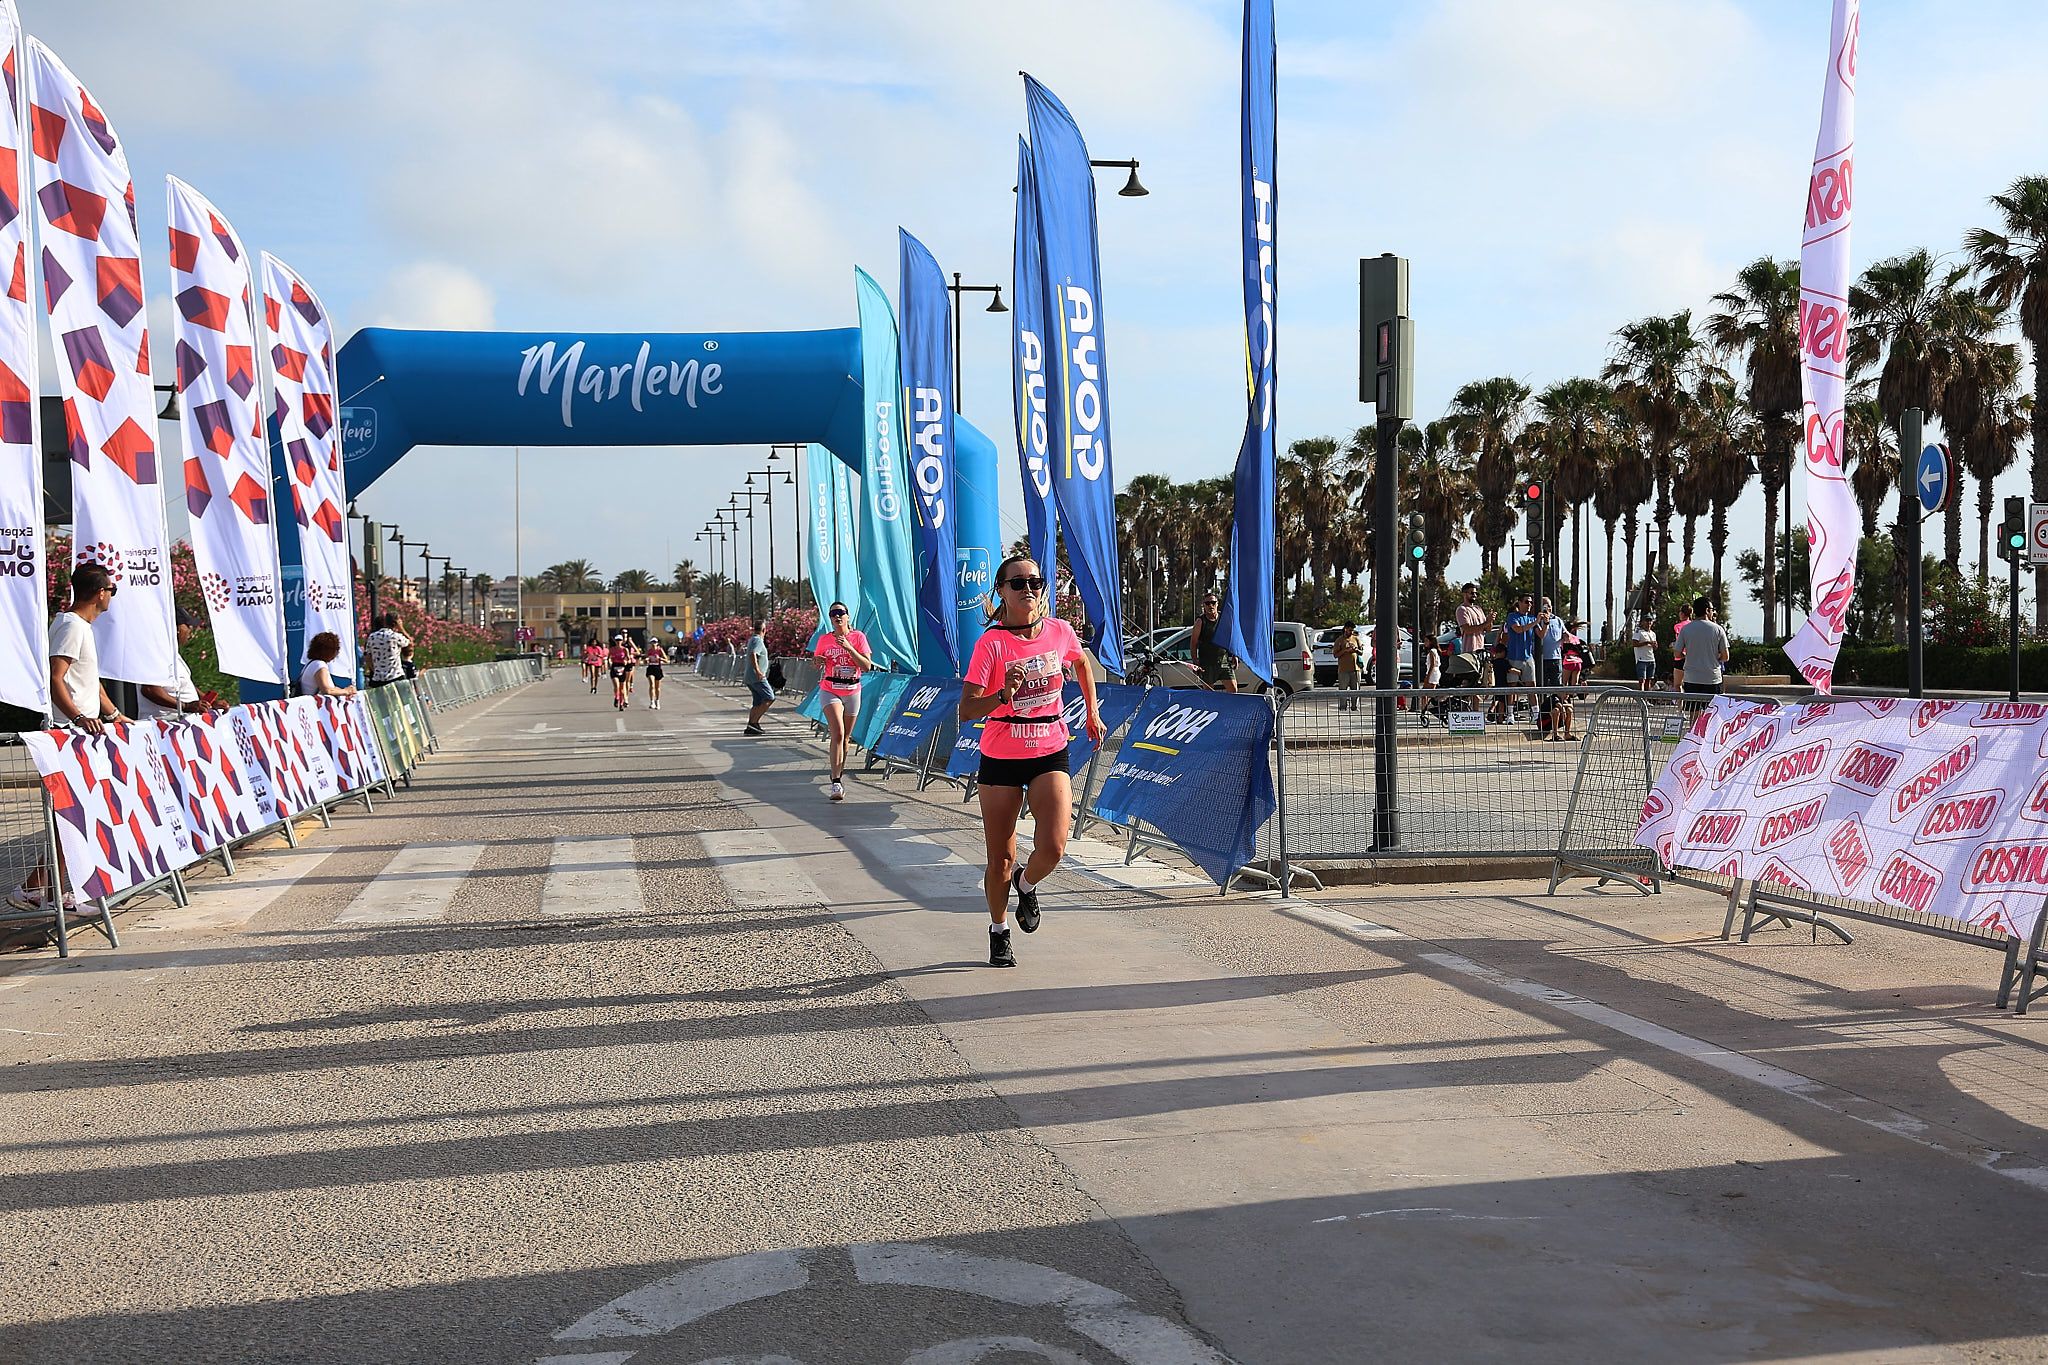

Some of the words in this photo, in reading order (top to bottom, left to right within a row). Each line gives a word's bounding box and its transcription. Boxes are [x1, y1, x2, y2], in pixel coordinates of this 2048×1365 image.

[517, 340, 723, 428] Marlene
[343, 420, 372, 442] lene
[957, 562, 987, 587] lene
[1011, 723, 1050, 739] MUJER
[1144, 703, 1219, 744] GOYA
[1718, 723, 1775, 782] COSMO
[1761, 744, 1825, 790] COSMO
[1839, 747, 1898, 789] COSMO
[1897, 744, 1971, 813] COSMO
[1687, 815, 1742, 845] COSMO
[1759, 800, 1822, 847] COSMO
[1923, 795, 1997, 837] COSMO
[1830, 819, 1869, 888] COSMO
[1879, 856, 1936, 912] COSMO
